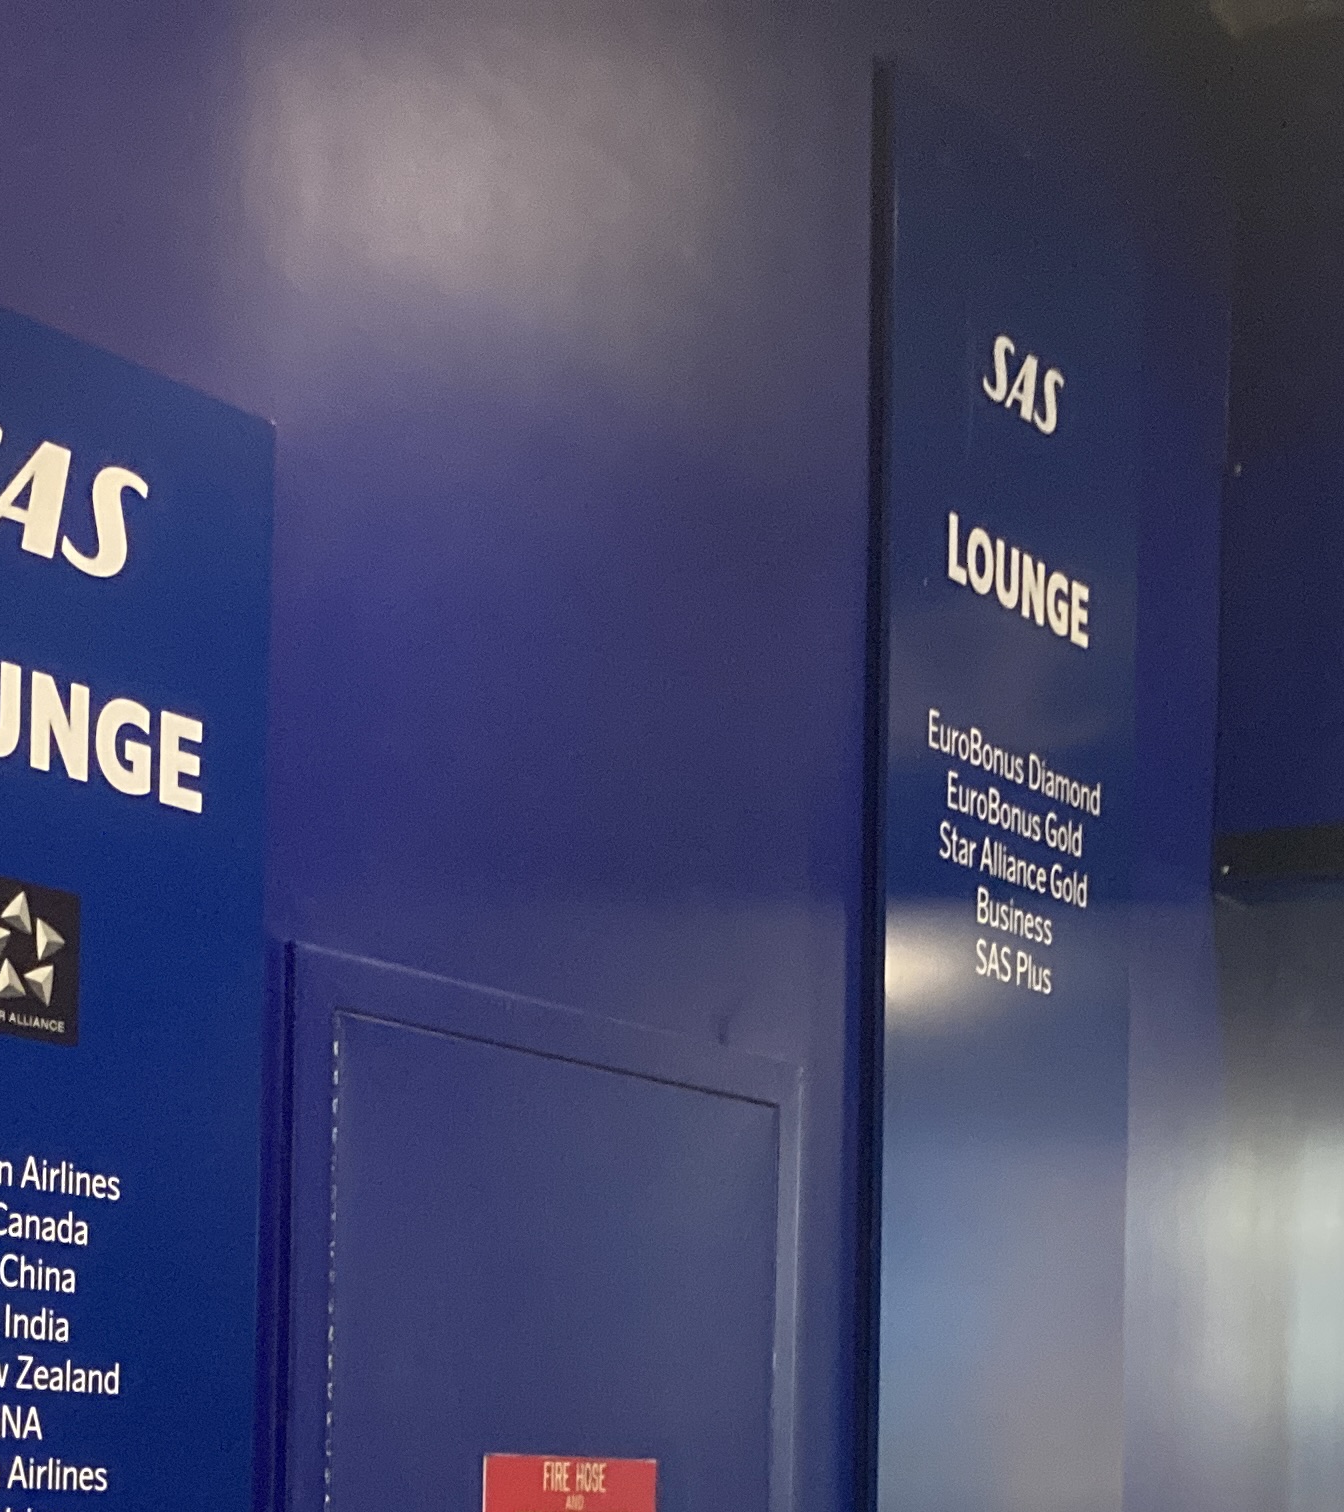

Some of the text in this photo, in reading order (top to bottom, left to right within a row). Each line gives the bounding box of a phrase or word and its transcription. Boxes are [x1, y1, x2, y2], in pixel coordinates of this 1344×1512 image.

[983, 335, 1065, 435] SAS
[948, 511, 1089, 649] LOUNGE
[928, 708, 1101, 816] EuroBonus Diamond
[947, 770, 1083, 857] EuroBonus Gold
[939, 821, 1088, 908] Star Alliance Gold
[977, 886, 1052, 945] Business
[976, 938, 1052, 994] SAS Plus
[9, 1012, 65, 1033] ALLIANCE
[20, 1156, 120, 1200] Airlines
[0, 1254, 76, 1293] China
[5, 1304, 69, 1342] India
[16, 1355, 120, 1395] Zealand
[7, 1455, 108, 1491] Airlines
[543, 1461, 606, 1493] FIRE HOSE
